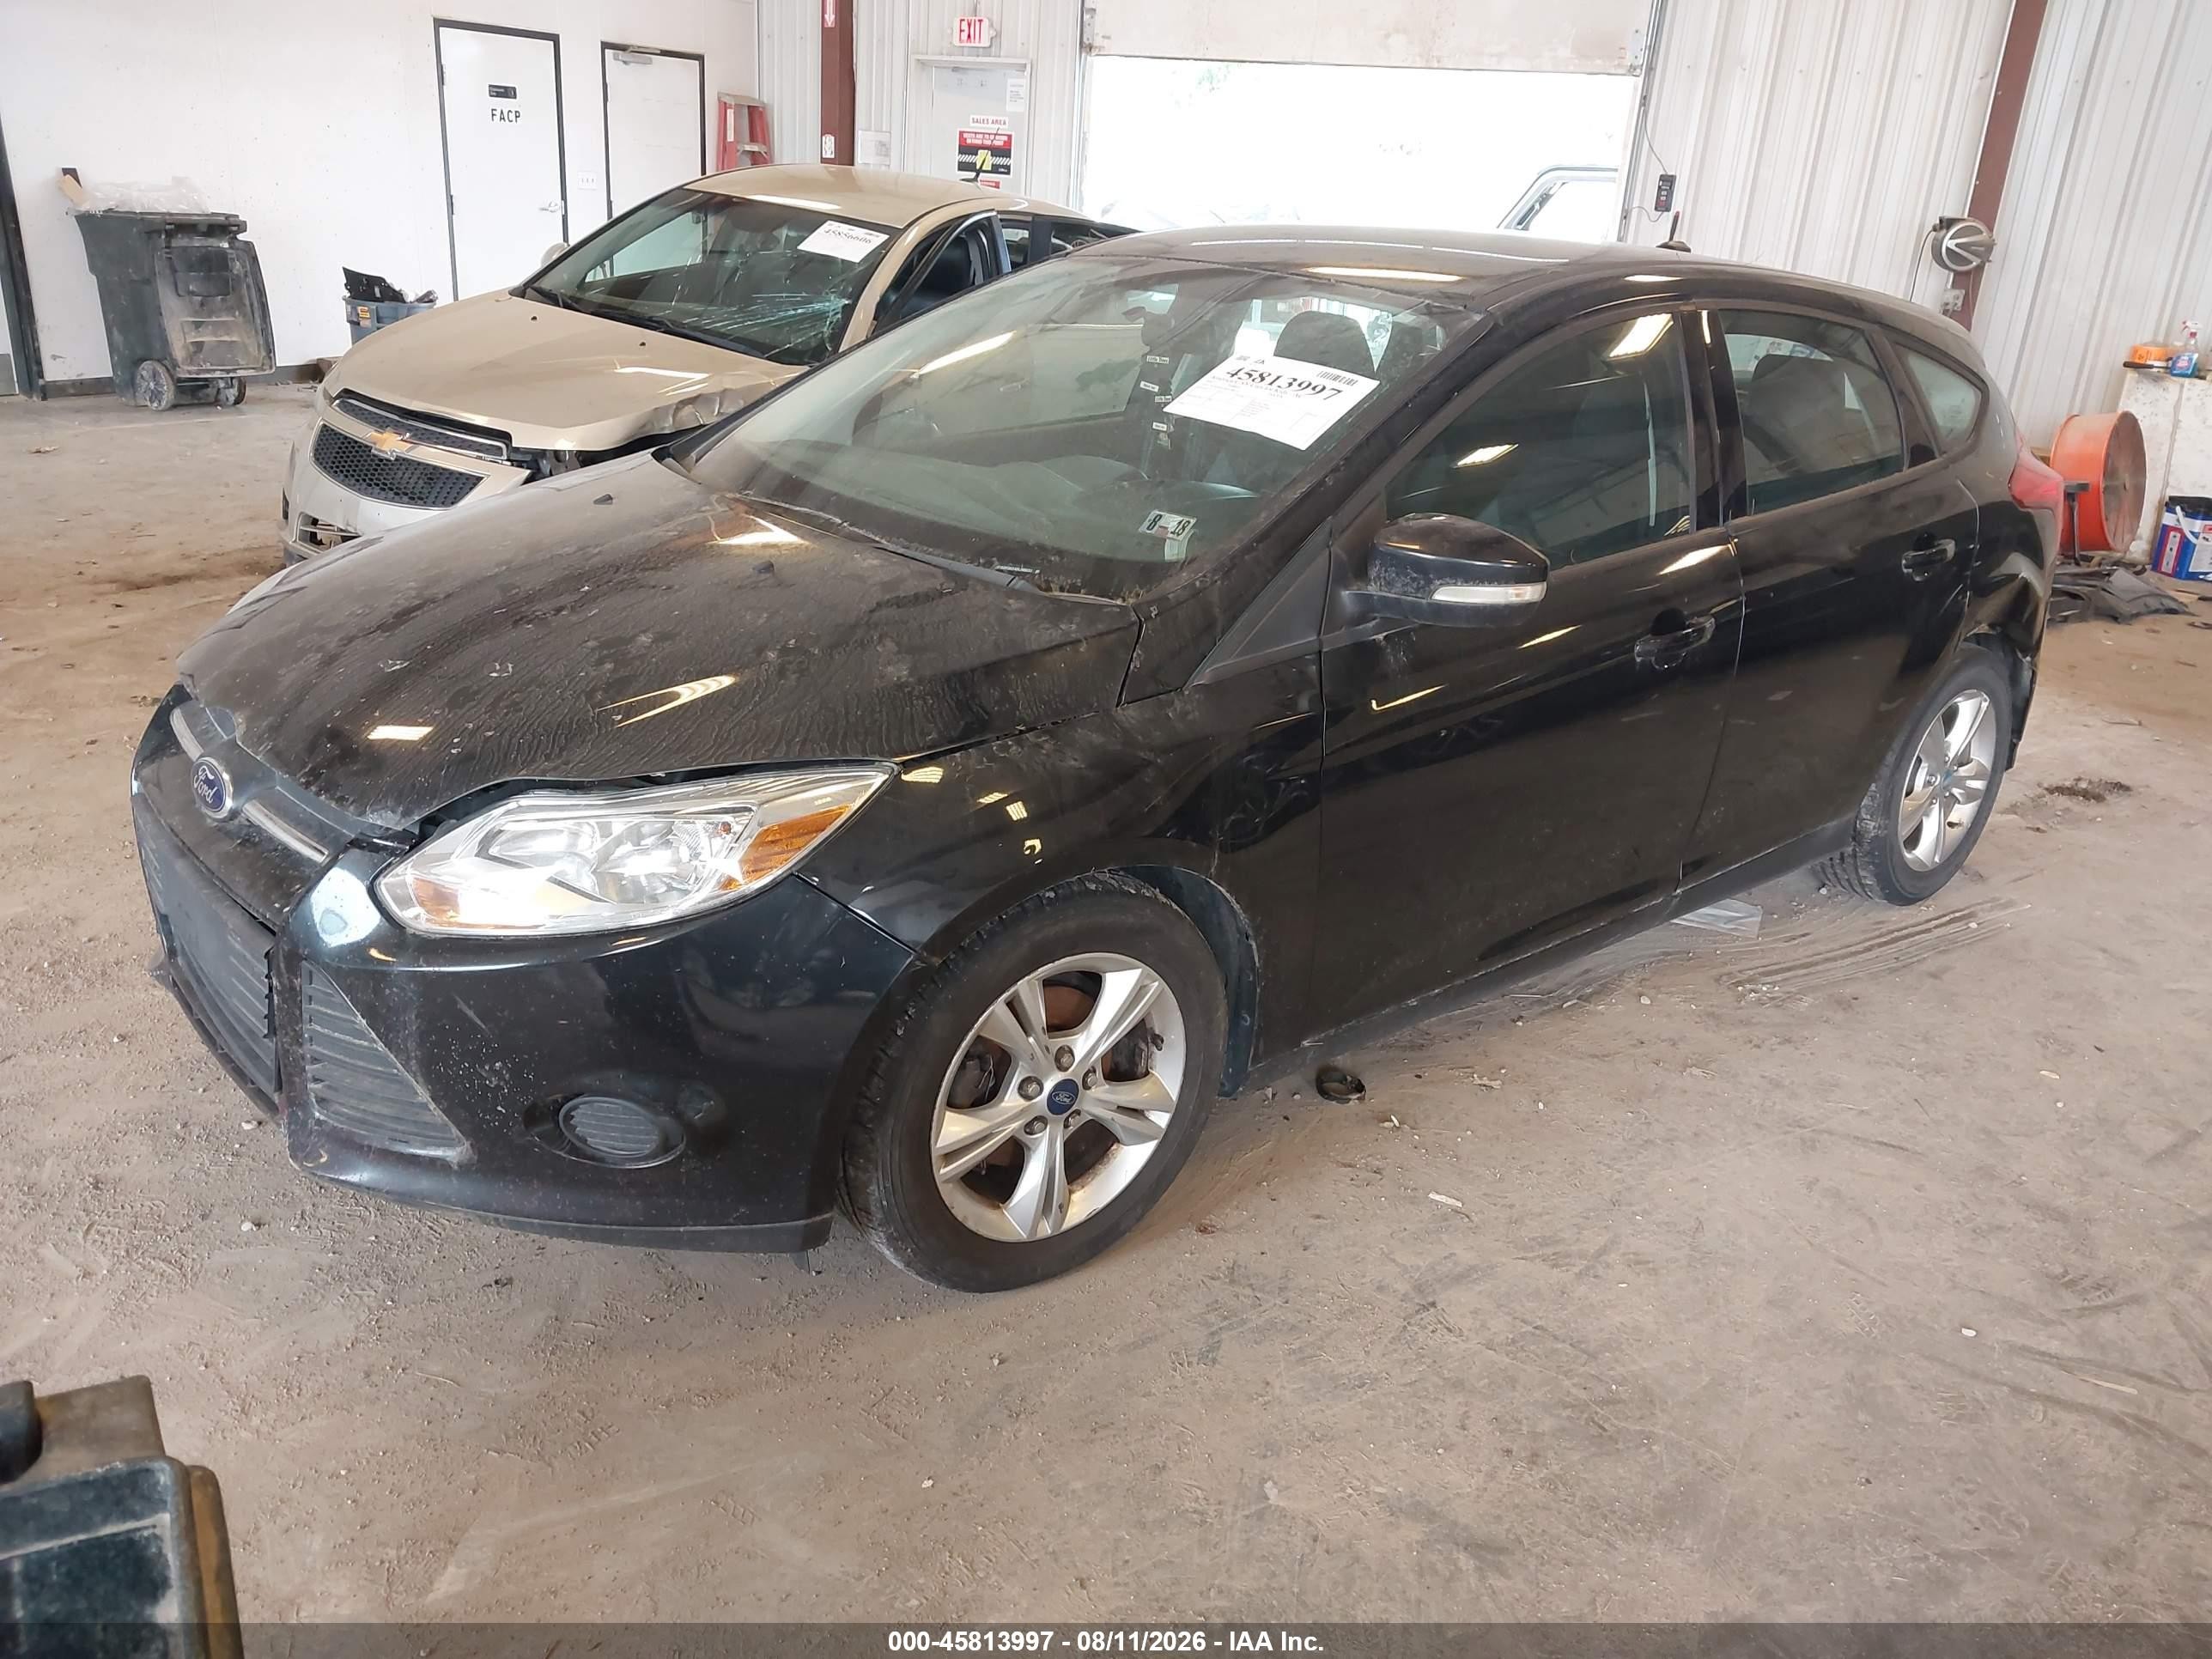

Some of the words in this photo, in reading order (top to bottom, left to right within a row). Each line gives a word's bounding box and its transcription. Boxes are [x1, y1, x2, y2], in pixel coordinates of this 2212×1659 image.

[959, 19, 983, 43] EXIT
[491, 108, 520, 124] FACP
[1227, 368, 1343, 400] 45813997
[1146, 514, 1163, 531] 8
[1170, 519, 1191, 537] 18
[194, 765, 218, 804] Ford
[1056, 1092, 1073, 1103] Ford
